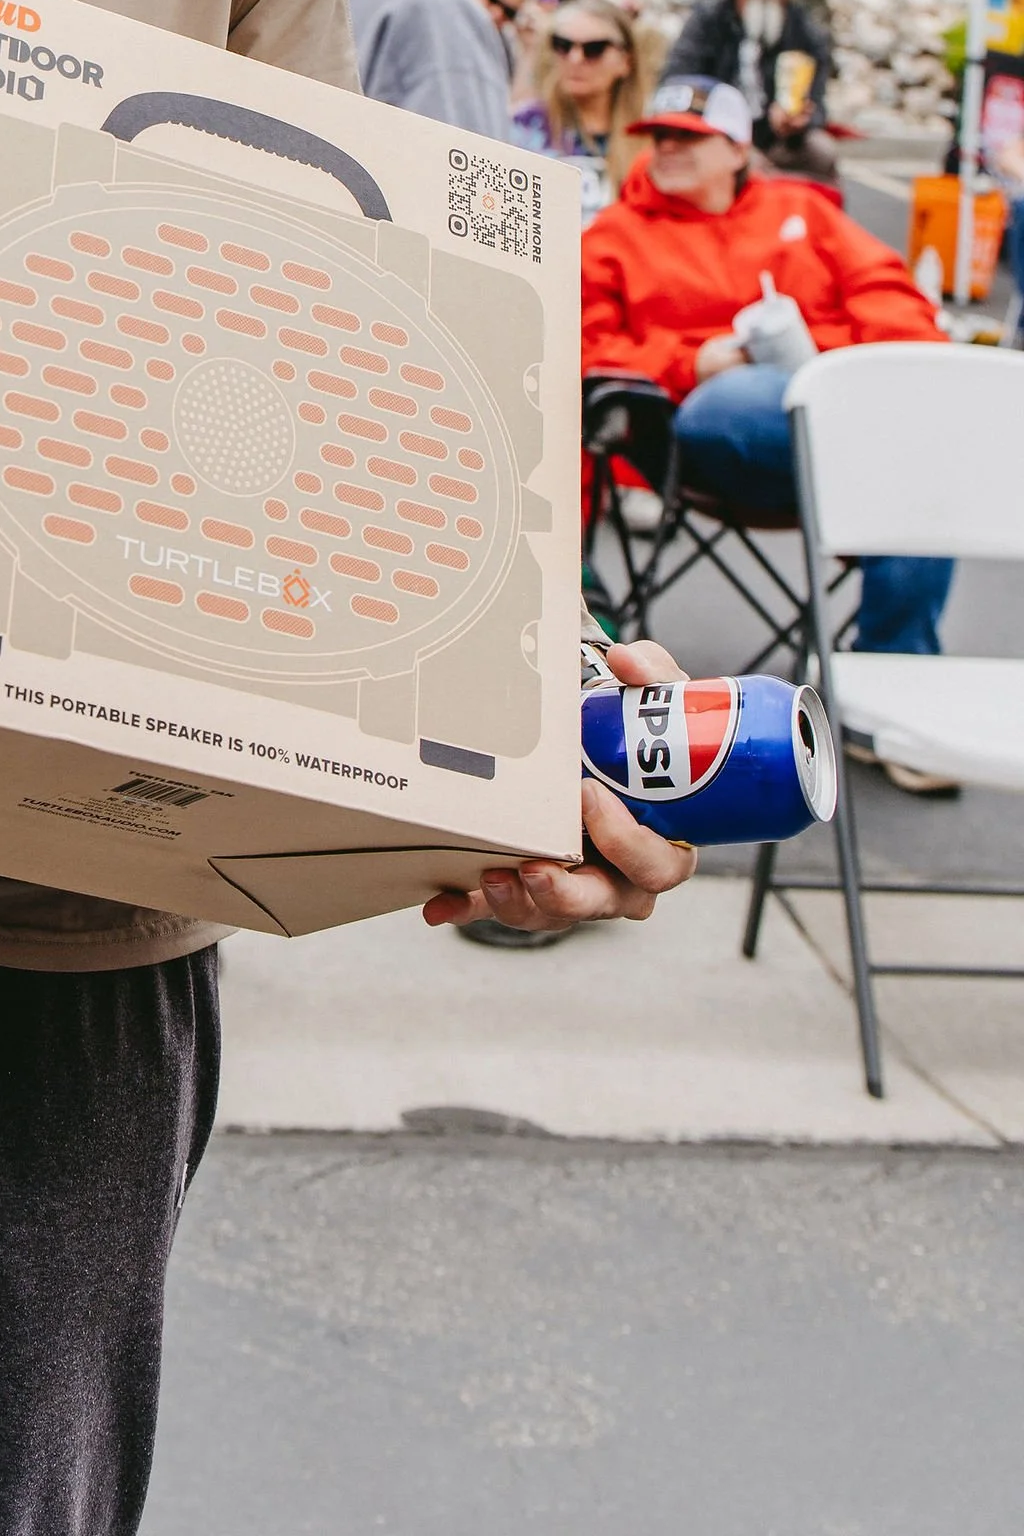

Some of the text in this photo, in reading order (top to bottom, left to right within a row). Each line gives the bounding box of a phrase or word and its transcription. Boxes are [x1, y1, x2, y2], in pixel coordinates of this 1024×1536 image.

[531, 174, 542, 265] LEARN MORE
[116, 534, 332, 612] TURTLEBOX
[4, 684, 409, 791] THIS PORTABLE SPEAKER IS 100% WATERPROOF
[636, 685, 676, 789] EPSI
[23, 797, 182, 836] TURTLEBOXAUDIO.COM
